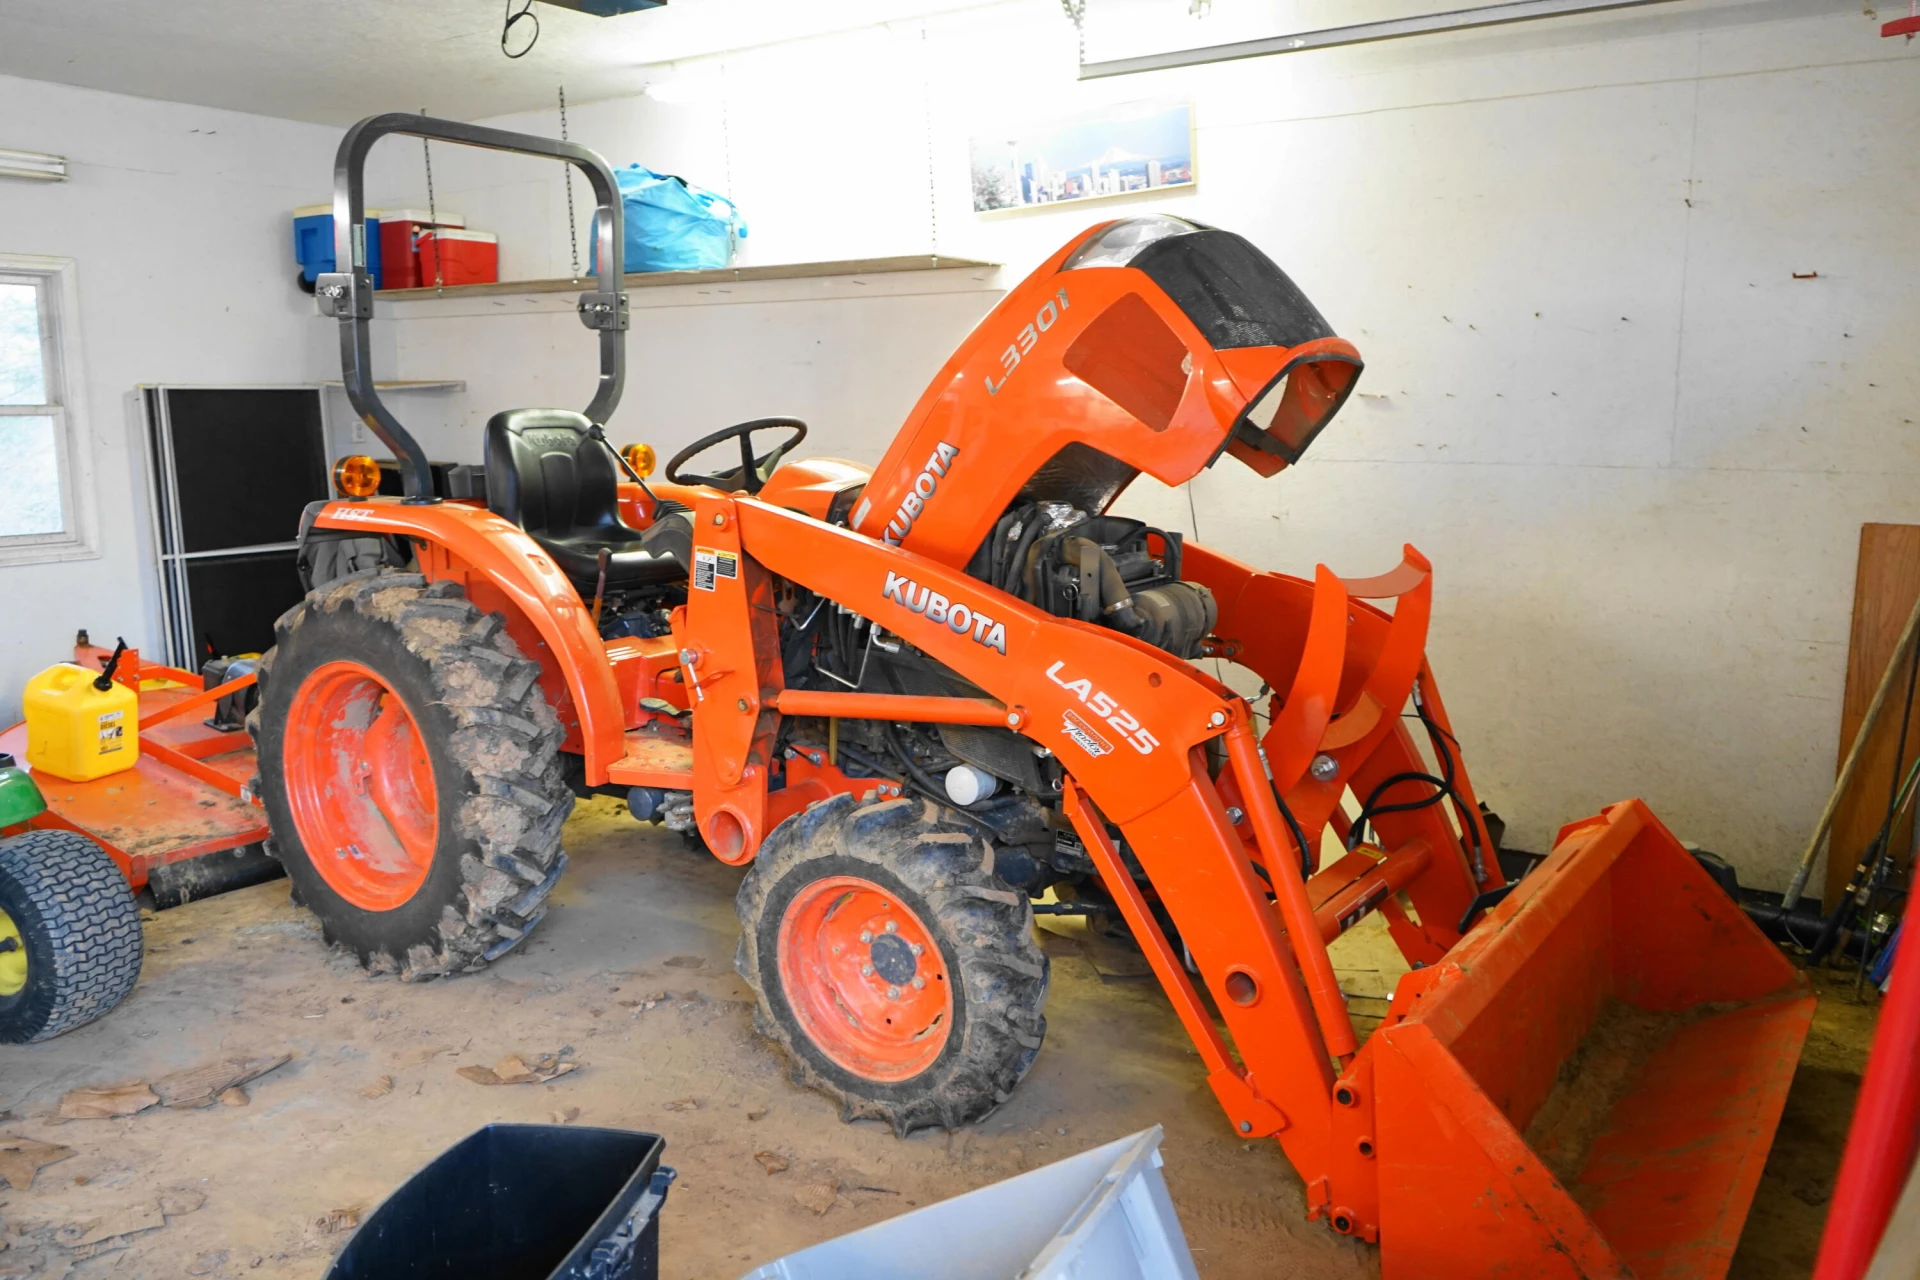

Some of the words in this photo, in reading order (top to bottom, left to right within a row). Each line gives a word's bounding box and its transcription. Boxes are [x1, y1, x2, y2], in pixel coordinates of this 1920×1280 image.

[985, 287, 1070, 396] L3301
[879, 440, 961, 547] KUBOTA
[882, 569, 1008, 656] KUBOTA
[1045, 660, 1161, 755] LA525
[1085, 728, 1110, 750] MOUNT
